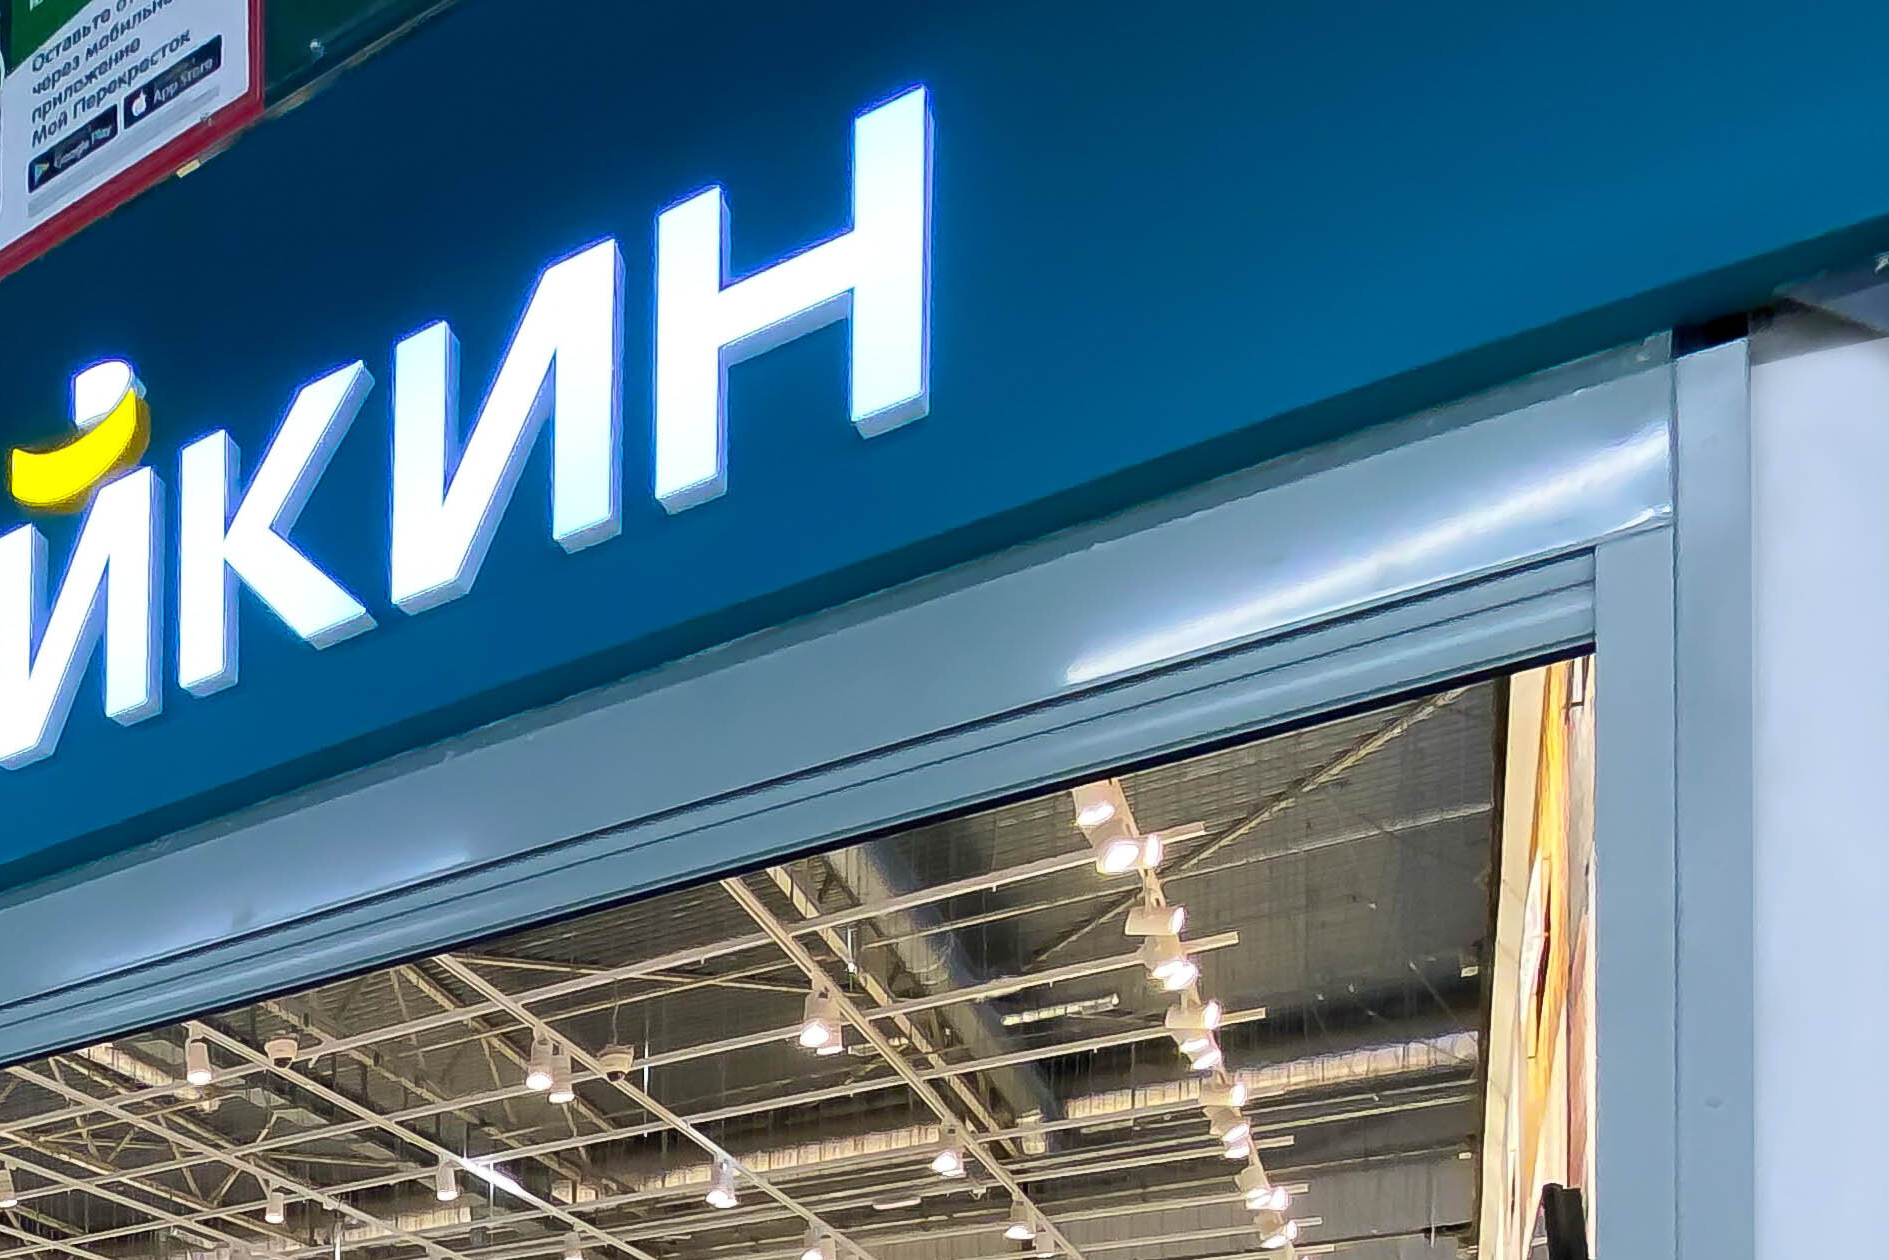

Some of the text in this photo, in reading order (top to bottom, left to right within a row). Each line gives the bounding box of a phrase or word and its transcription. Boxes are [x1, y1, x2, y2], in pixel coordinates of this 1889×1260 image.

[31, 0, 173, 95] через мобильн
[31, 37, 141, 125] приложение
[153, 80, 180, 105] App
[31, 111, 68, 148] Мой
